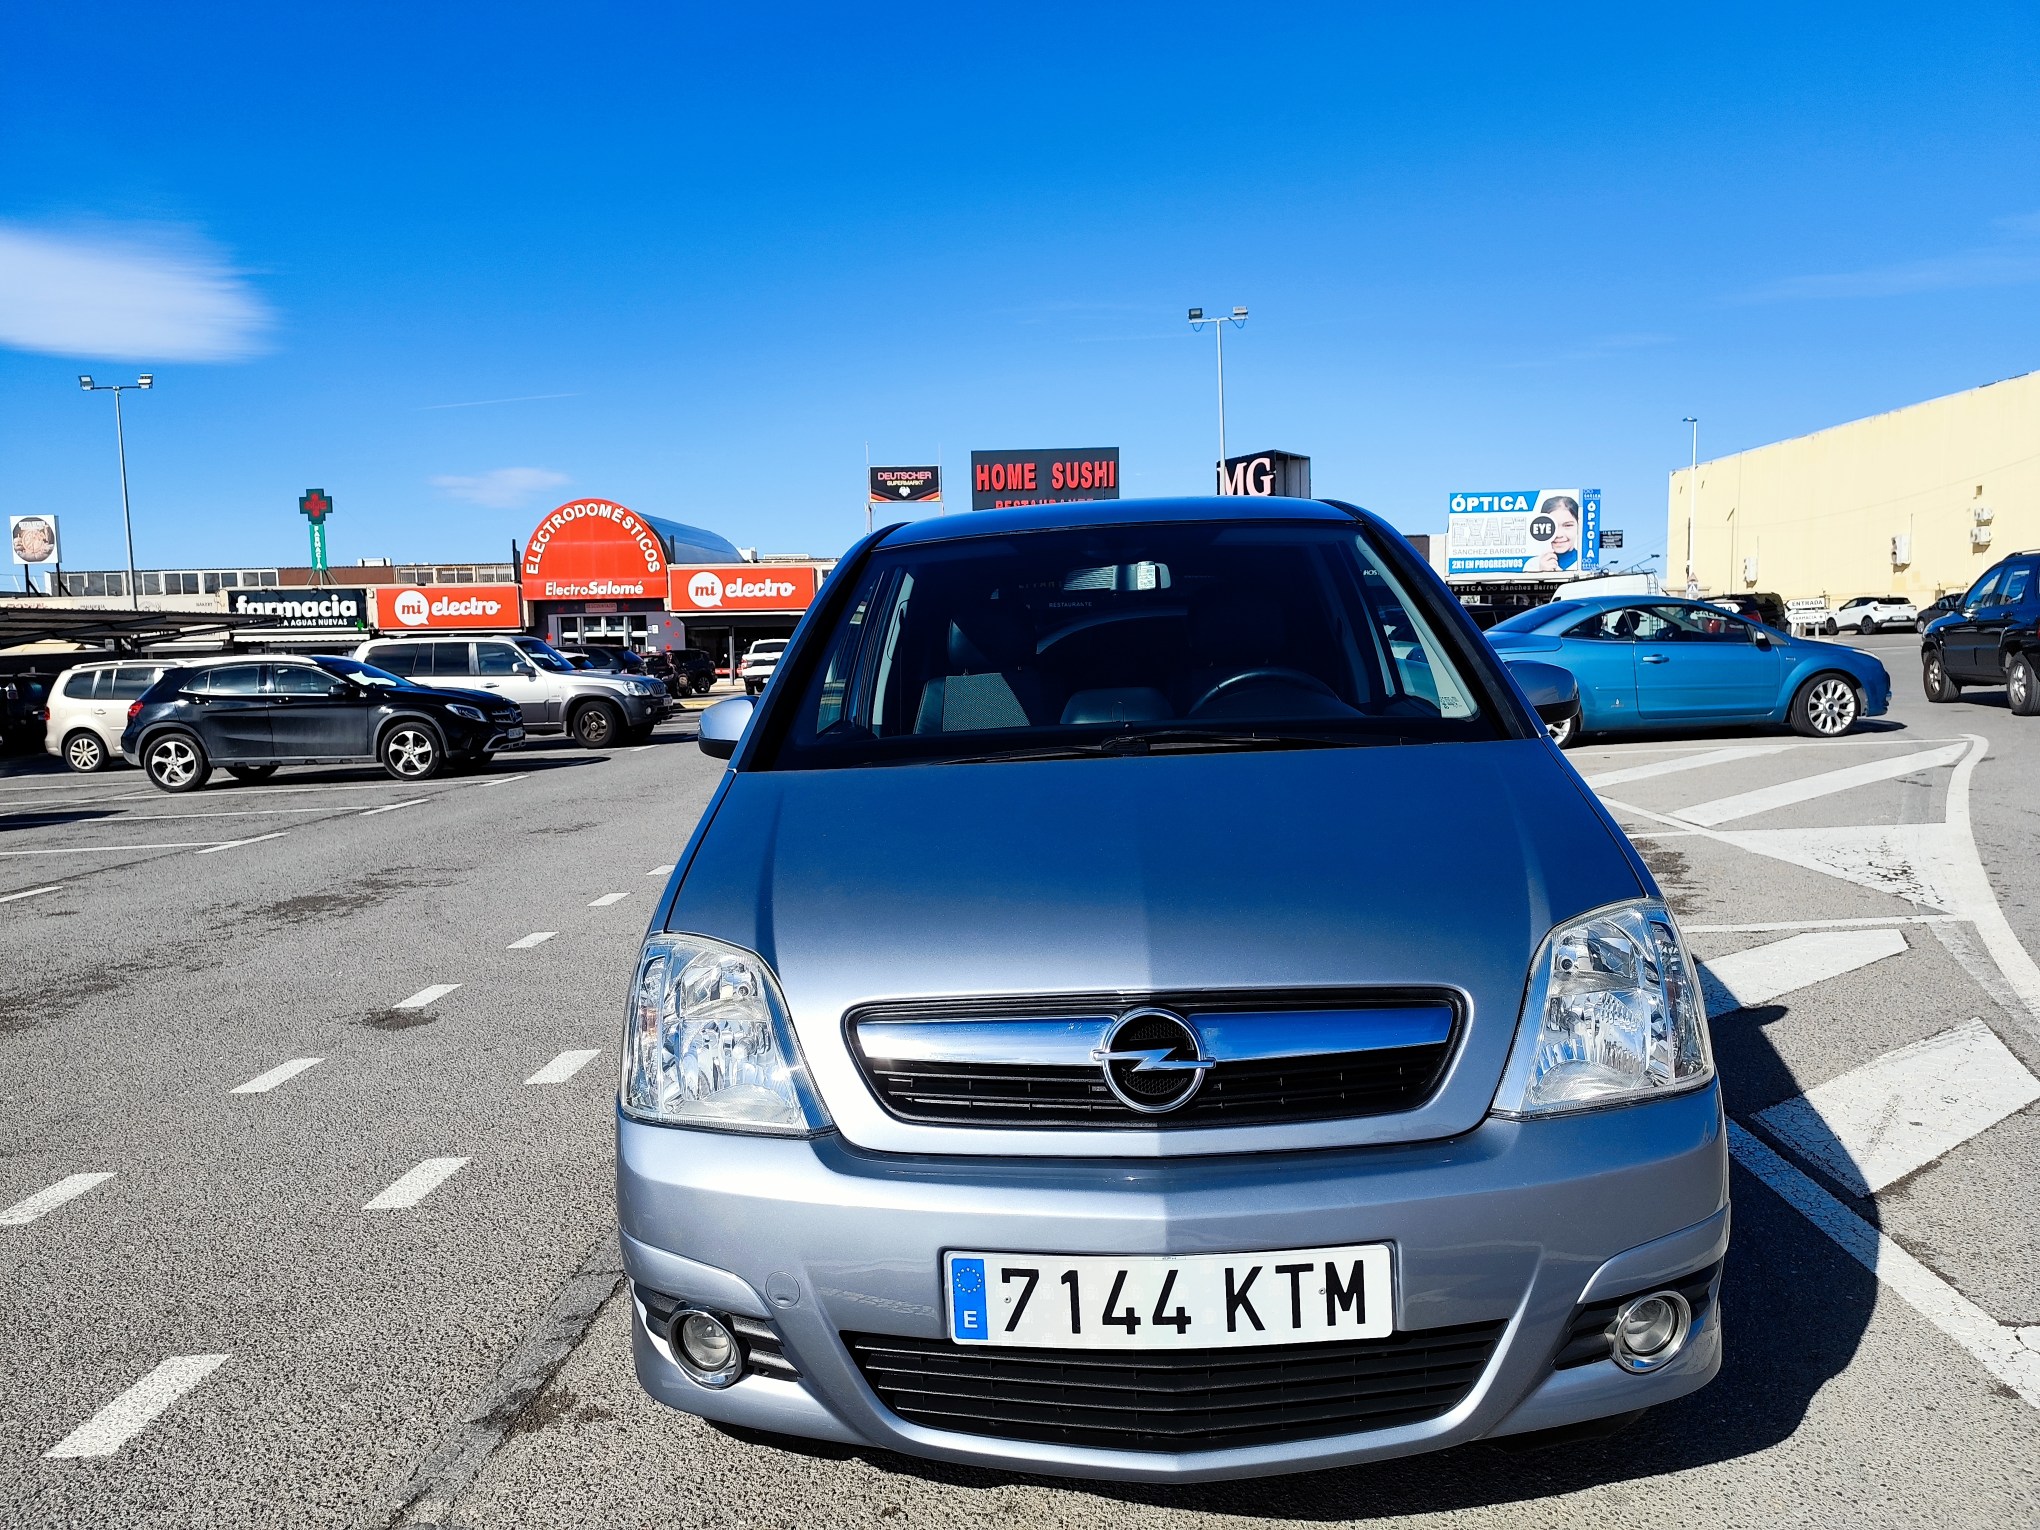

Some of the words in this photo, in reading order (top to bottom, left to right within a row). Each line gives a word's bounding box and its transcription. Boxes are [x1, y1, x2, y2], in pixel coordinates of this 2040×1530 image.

[877, 471, 932, 480] DEUTSCHER
[975, 462, 1037, 491] HOME
[1051, 460, 1115, 490] SUSHI
[1451, 494, 1529, 512] ÓPTICA
[1532, 523, 1552, 535] EYE
[314, 525, 323, 569] FARMACIA
[526, 503, 661, 575] ELECTRODOMÉSTICOS
[1489, 547, 1527, 555] BARREDO
[1465, 560, 1475, 568] EN
[1475, 558, 1524, 568] PROGRESIVOS
[545, 580, 644, 596] ElectroSalomé
[694, 582, 717, 597] mi
[724, 577, 797, 598] electro
[236, 594, 358, 618] farmacia
[401, 600, 423, 615] mi
[431, 596, 502, 617] electro
[1791, 599, 1823, 607] ENTRADA
[290, 618, 317, 627] AGUAS
[318, 618, 348, 626] NUEVAS
[964, 1310, 978, 1329] E
[1000, 1267, 1193, 1335] 7144
[1224, 1259, 1367, 1333] KTM
